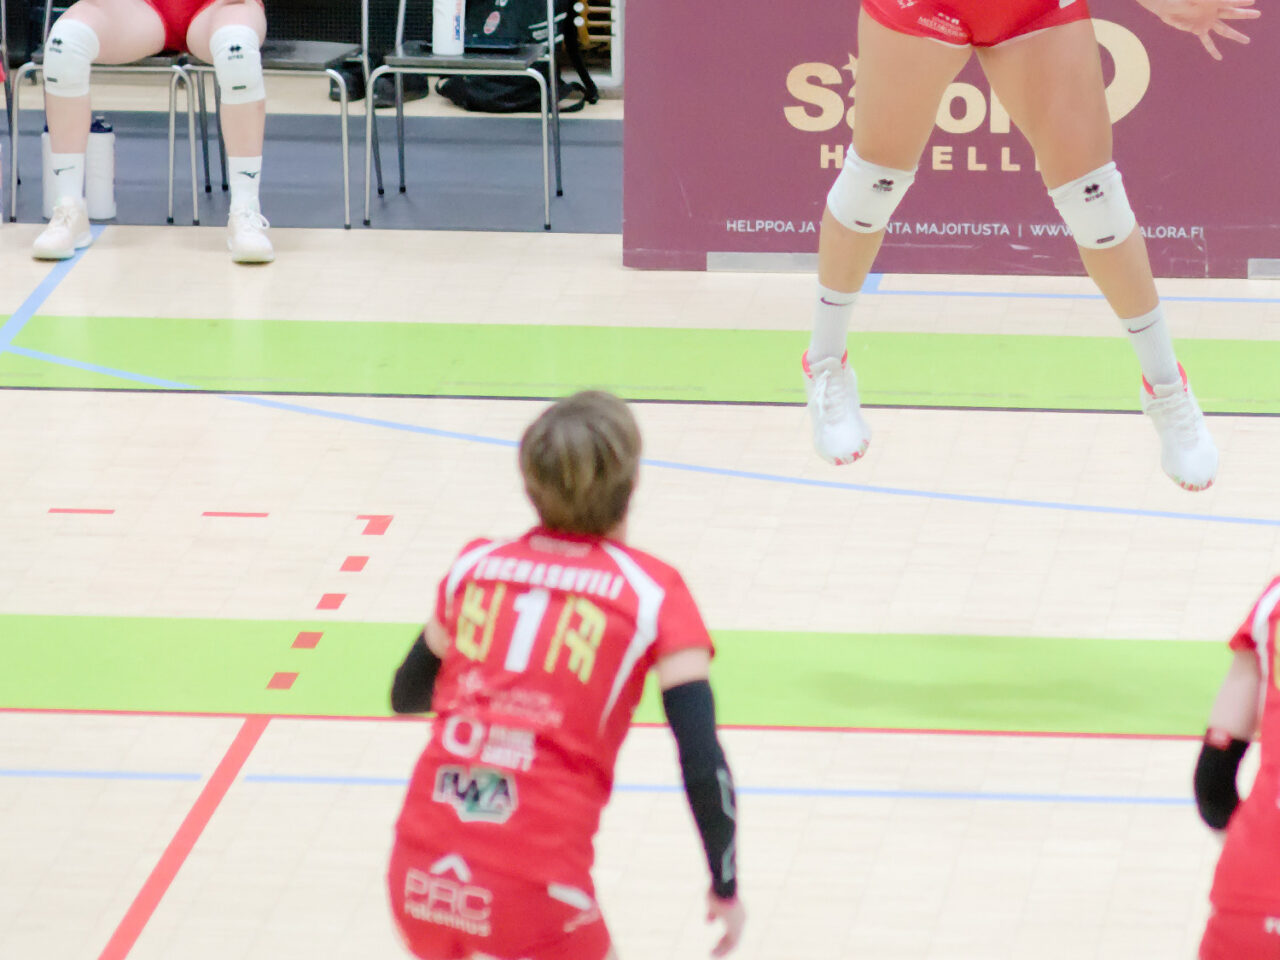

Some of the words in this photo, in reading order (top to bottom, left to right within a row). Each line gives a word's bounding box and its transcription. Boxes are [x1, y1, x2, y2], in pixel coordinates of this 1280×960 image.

[726, 219, 795, 233] HELPPOA
[798, 221, 816, 234] JA
[915, 222, 1010, 237] MAJOITUSTA
[503, 589, 550, 674] 1
